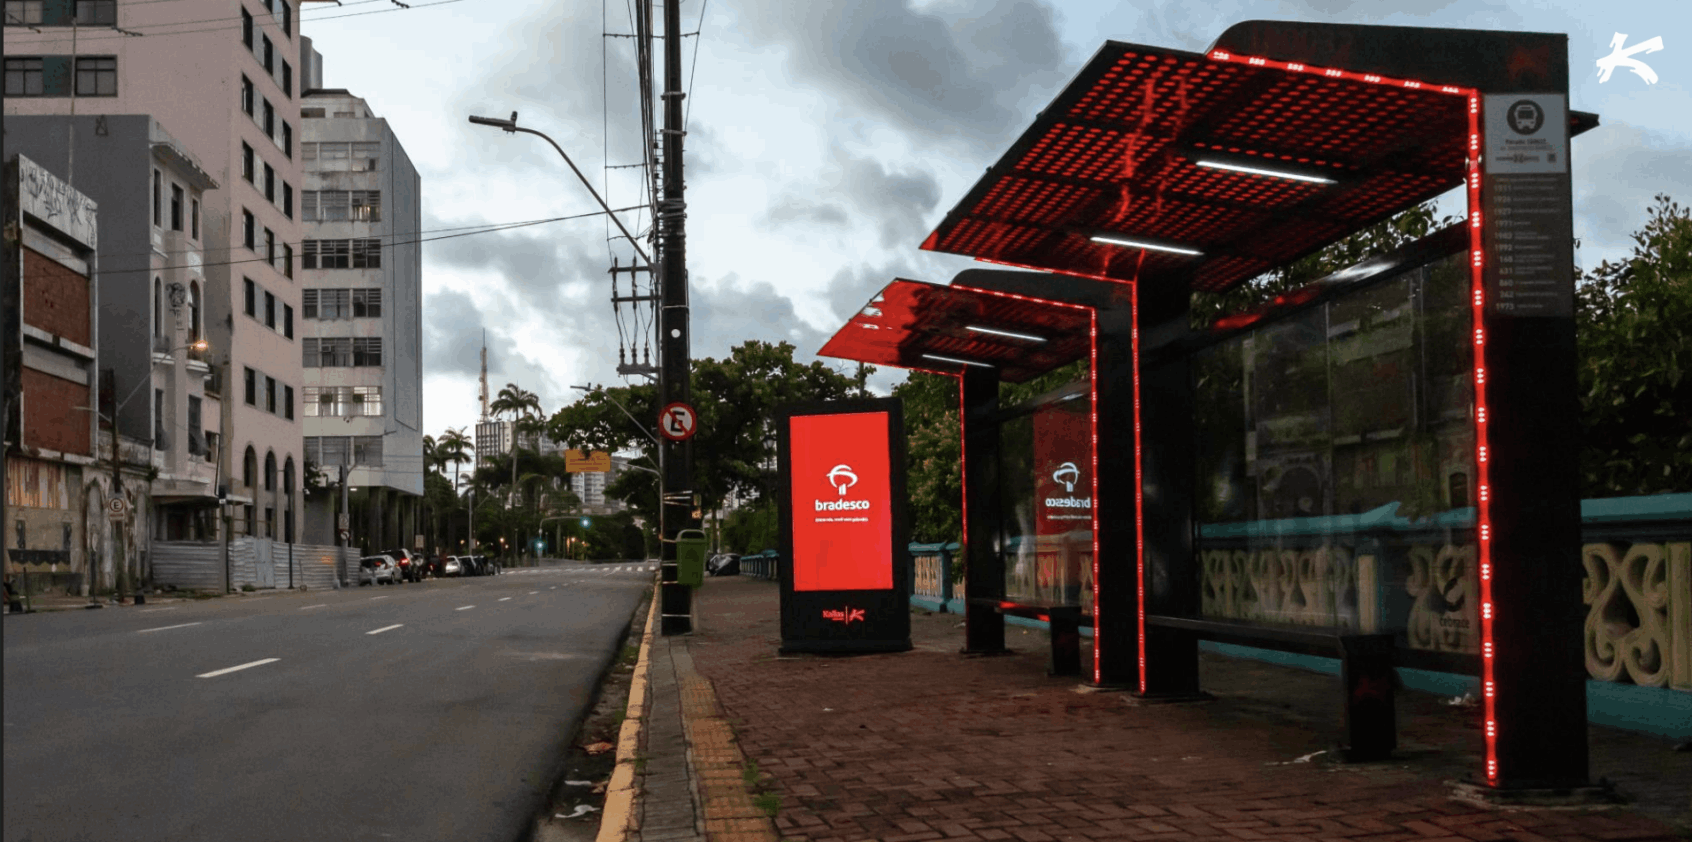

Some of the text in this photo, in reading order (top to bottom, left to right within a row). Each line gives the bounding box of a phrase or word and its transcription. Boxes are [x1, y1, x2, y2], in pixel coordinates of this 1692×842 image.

[671, 411, 685, 432] E
[113, 501, 119, 509] E
[814, 498, 870, 511] bradesco
